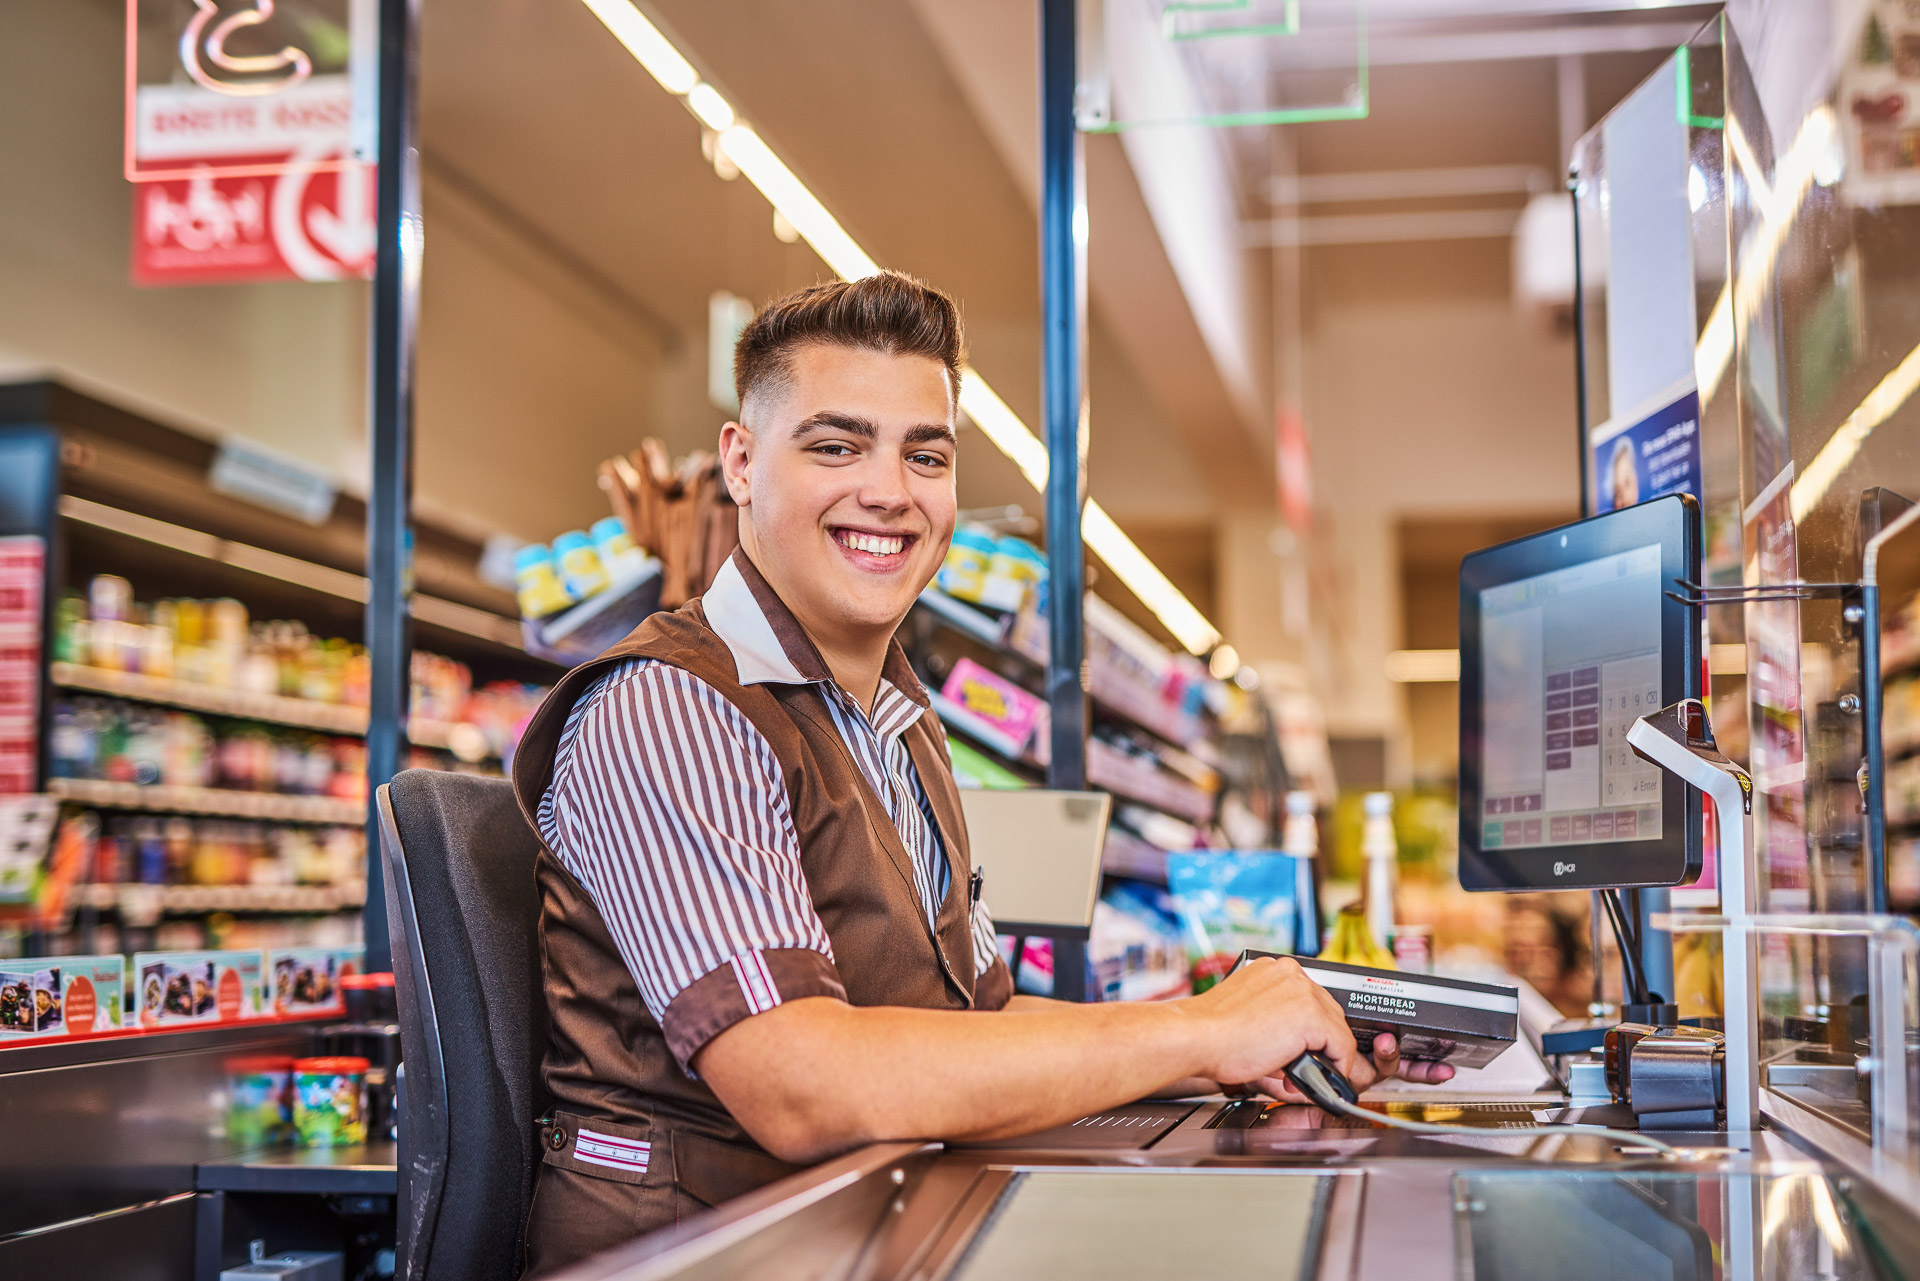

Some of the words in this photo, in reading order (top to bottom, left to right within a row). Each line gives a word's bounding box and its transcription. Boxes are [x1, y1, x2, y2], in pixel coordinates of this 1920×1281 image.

[1608, 698, 1613, 711] 7
[1621, 696, 1627, 709] 8
[1635, 694, 1640, 706] 9
[1608, 727, 1613, 738] 4
[1621, 725, 1627, 737] 5
[1621, 753, 1627, 765] 2
[1608, 783, 1613, 795] 0
[1640, 780, 1657, 792] Enter
[1362, 984, 1404, 993] PREMIUM
[1349, 992, 1415, 1009] SHORTBREAD
[1364, 1004, 1377, 1012] con
[1377, 1005, 1394, 1014] burro
[1395, 1008, 1416, 1017] italiano
